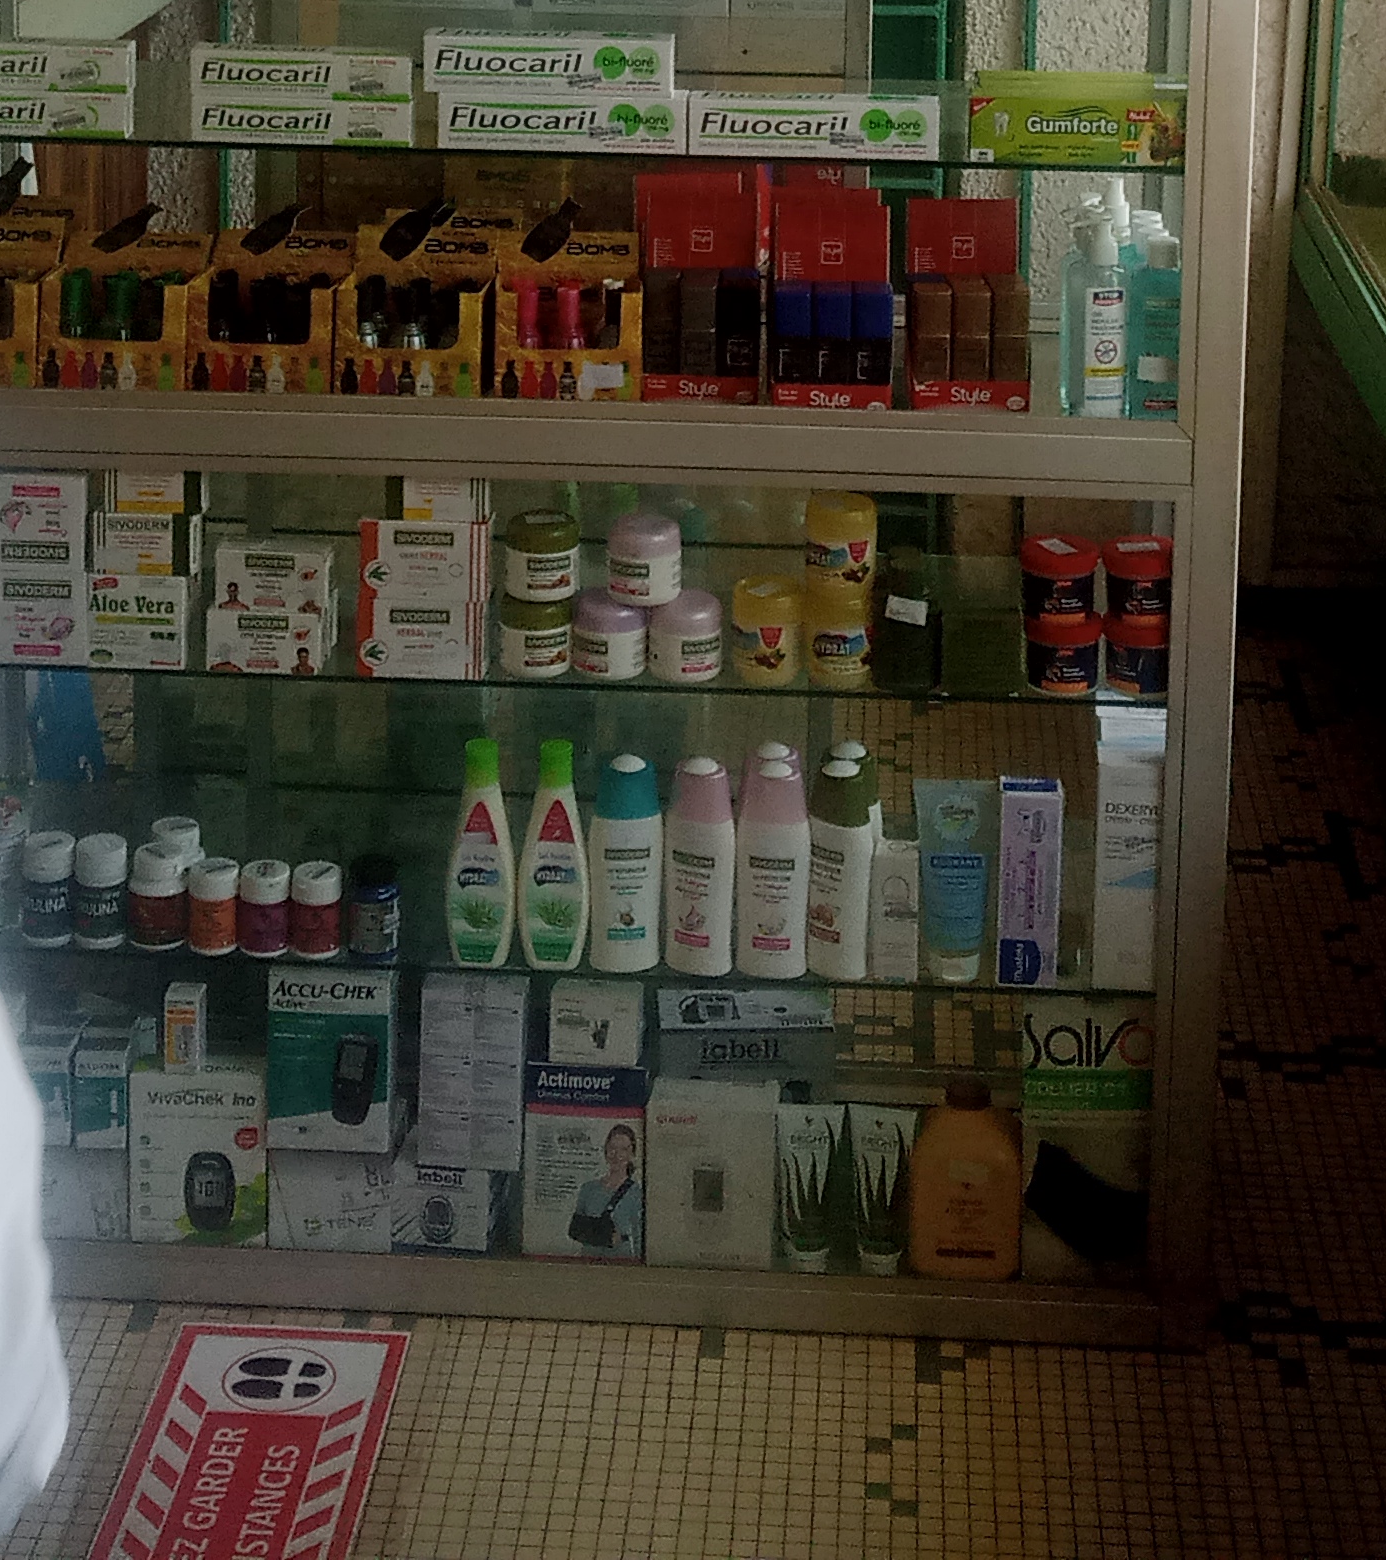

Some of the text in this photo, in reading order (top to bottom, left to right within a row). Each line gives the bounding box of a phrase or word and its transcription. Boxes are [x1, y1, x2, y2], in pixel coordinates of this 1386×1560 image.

[201, 61, 331, 83] Fluocaril
[435, 50, 655, 73] Fluocaril bi-fluoré
[202, 108, 331, 129] Fluocaril
[450, 107, 596, 130] Fluocaril
[700, 113, 921, 136] Fluocaril bi-fluoré
[1027, 117, 1118, 133] Gumforte
[424, 239, 489, 254] BOMB
[567, 243, 630, 255] BOMB
[679, 380, 719, 399] Style
[810, 391, 850, 409] Style
[951, 387, 991, 404] Style
[89, 593, 175, 614] Aloe Vera
[273, 980, 377, 1001] ACCU-CHEK
[538, 1071, 610, 1090] Actimove
[148, 1091, 224, 1107] VivaChek
[183, 1426, 250, 1531] GARDER
[232, 1443, 301, 1560] ISTANCES
